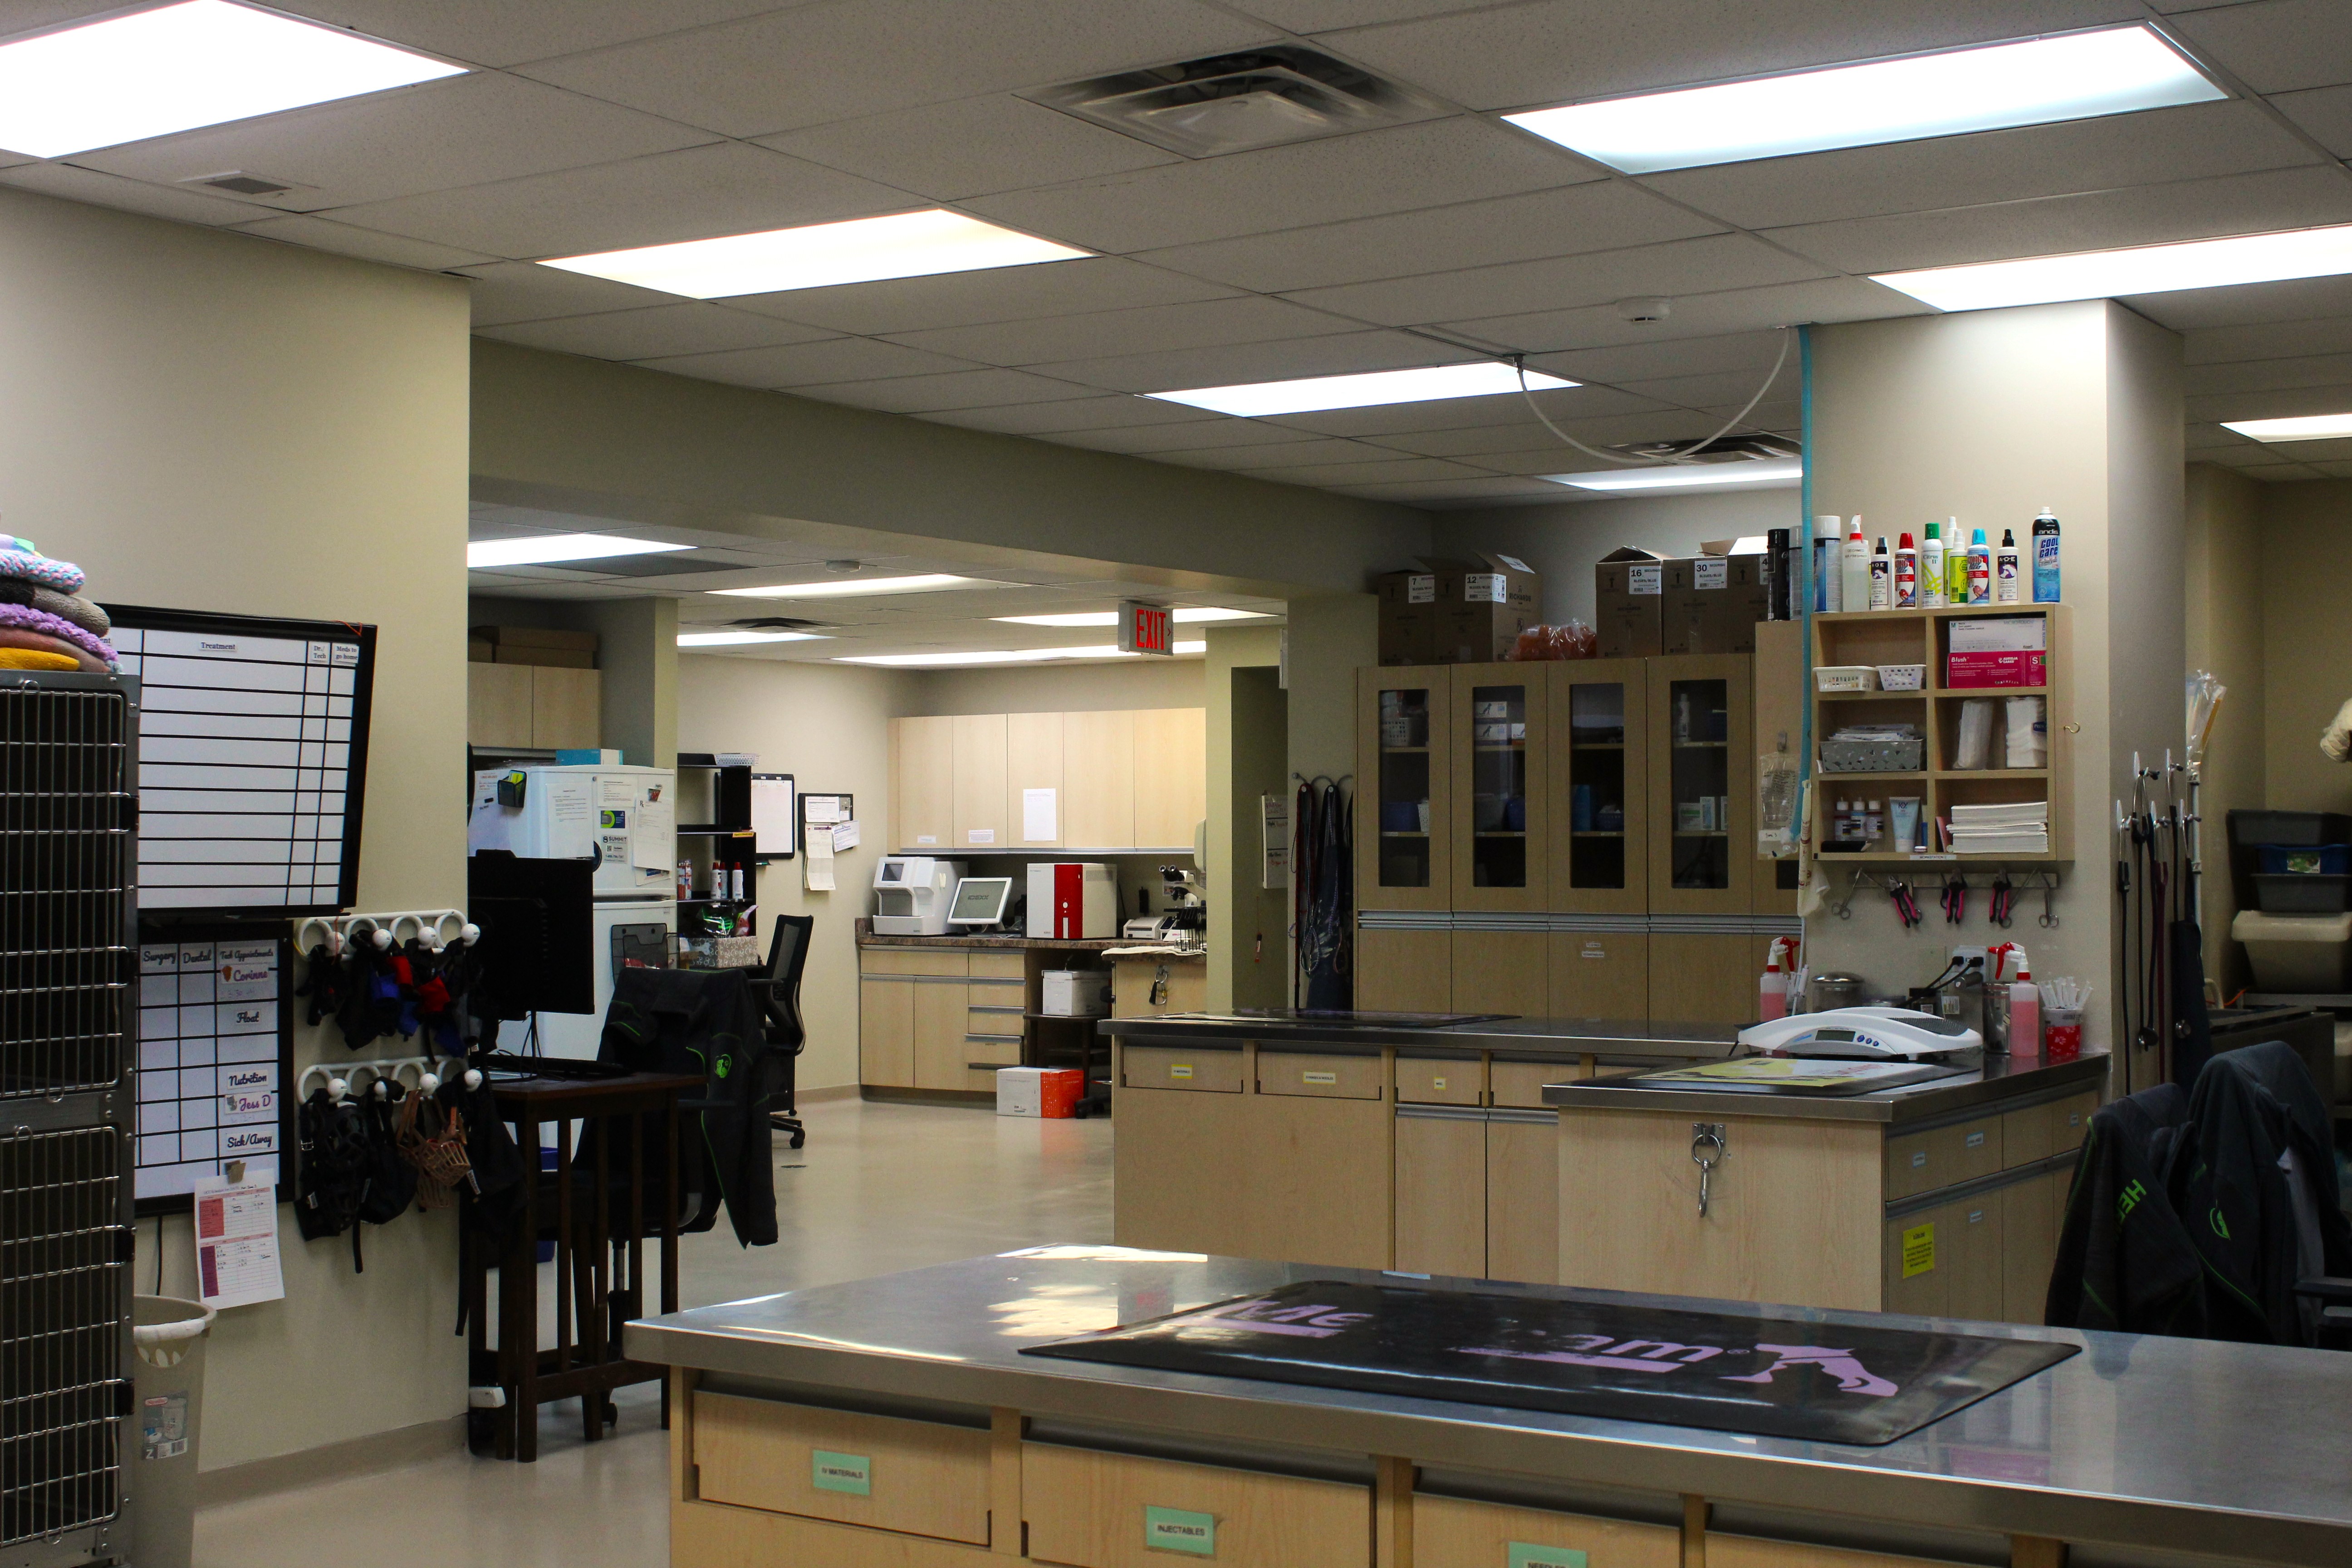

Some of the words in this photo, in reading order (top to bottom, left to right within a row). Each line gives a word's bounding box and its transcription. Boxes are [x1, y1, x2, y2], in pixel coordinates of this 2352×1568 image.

[1509, 593, 1532, 602] RICHARDS
[1136, 609, 1166, 650] EXIT
[201, 642, 235, 650] Treatment
[143, 951, 176, 966] Surgery
[183, 950, 212, 964] Dental
[233, 969, 269, 982] Corinne
[236, 1011, 260, 1023] Float
[229, 1072, 267, 1087] Nutrition
[239, 1098, 260, 1112] Jess
[262, 1094, 271, 1107] D
[227, 1133, 273, 1148] Sick/Away
[828, 1468, 863, 1479] MATERIALS
[1157, 1524, 1205, 1536] INJECTABLES
